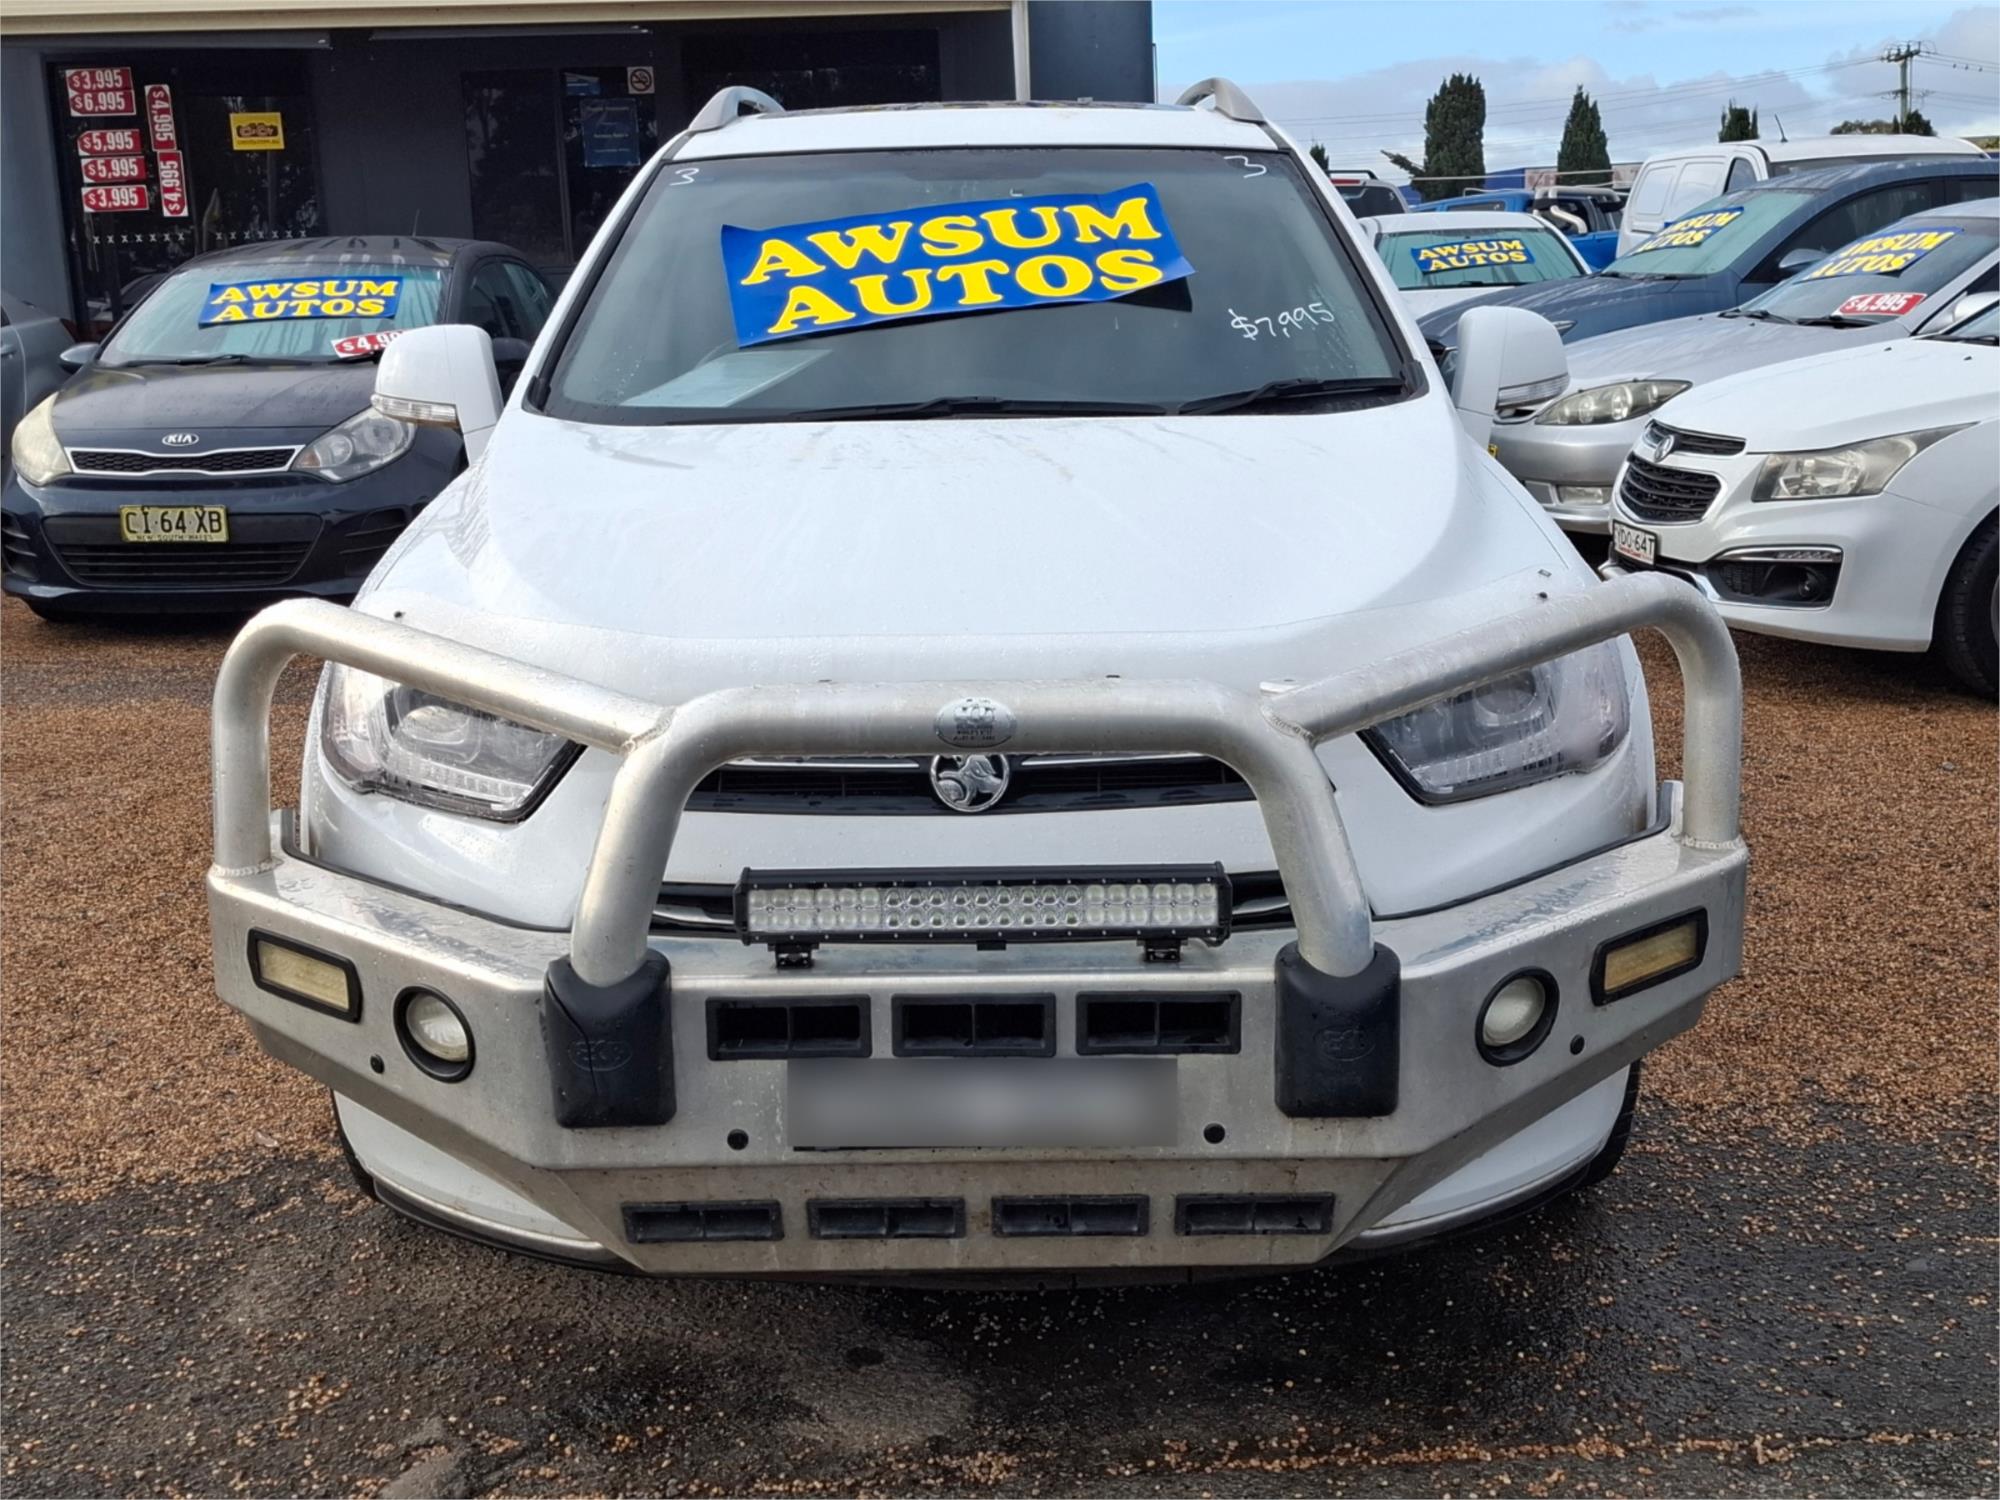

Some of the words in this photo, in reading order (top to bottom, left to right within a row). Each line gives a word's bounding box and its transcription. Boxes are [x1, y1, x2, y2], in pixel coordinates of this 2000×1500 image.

[72, 69, 123, 90] $3,995
[74, 91, 125, 112] $6,995
[151, 91, 174, 142] $4,995
[83, 131, 133, 152] $5,995
[88, 158, 138, 179] $5,995
[160, 160, 182, 211] $4,995
[88, 187, 138, 208] $3,995
[740, 197, 1162, 286] AWSUM
[1419, 240, 1525, 260] AWSUM
[1429, 251, 1528, 271] AUTOS
[210, 280, 400, 305] AWSUM
[768, 249, 1163, 334] AUTOS
[210, 298, 385, 322] AUTOS
[1845, 294, 1912, 312] $4,995
[1228, 302, 1335, 341] $7,995
[167, 433, 193, 444] KIA
